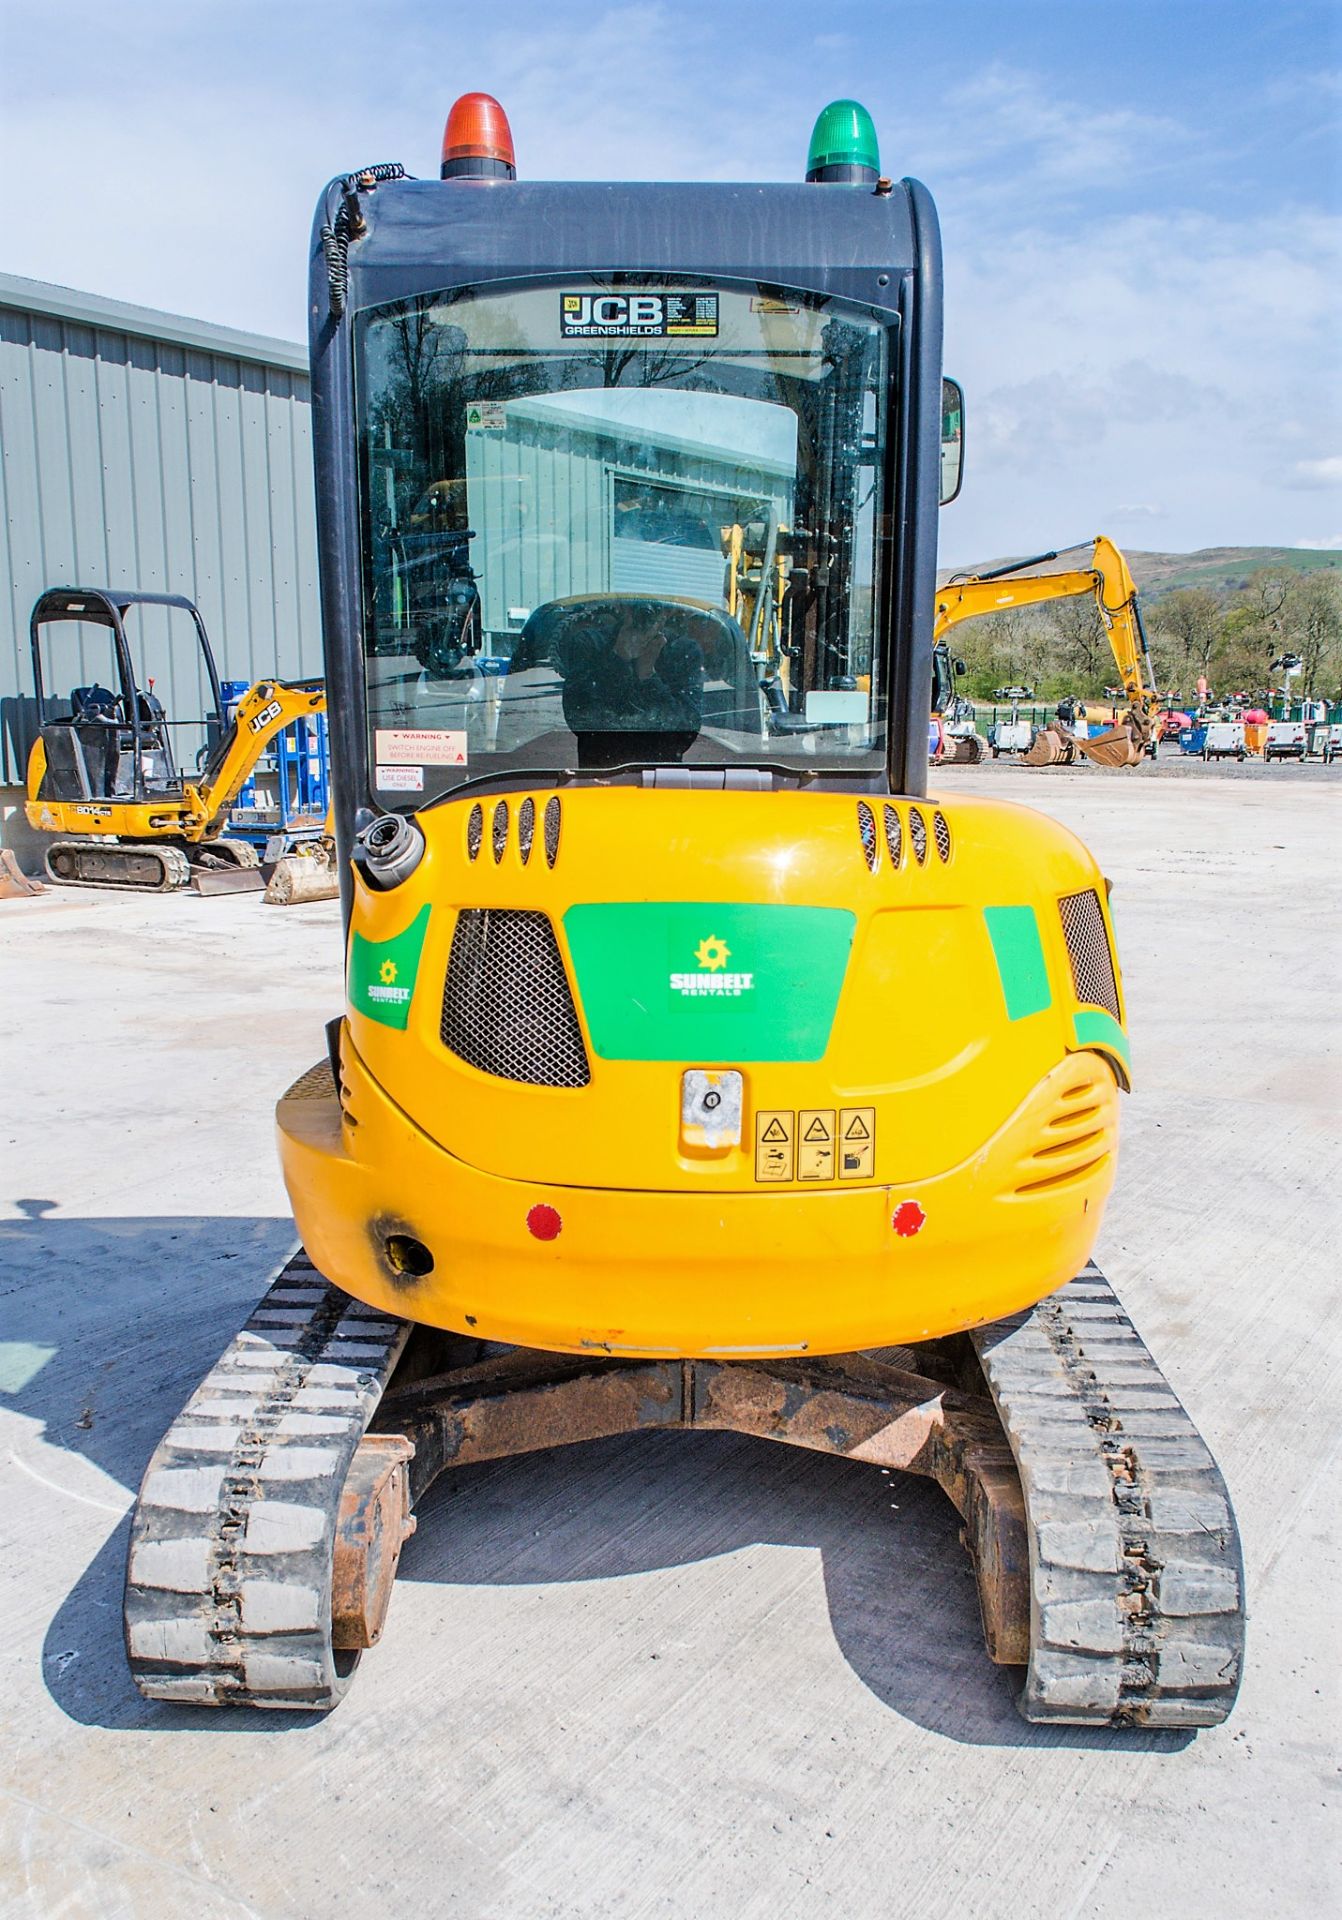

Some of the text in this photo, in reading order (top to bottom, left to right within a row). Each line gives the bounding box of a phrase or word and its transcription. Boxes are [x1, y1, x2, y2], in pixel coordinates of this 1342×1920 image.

[565, 297, 663, 326] JCB
[565, 326, 663, 335] GREENSHIELDS
[249, 701, 283, 733] JCB
[77, 806, 99, 816] 8014
[669, 973, 753, 990] SUNBELT
[368, 985, 410, 1000] SUNBELT
